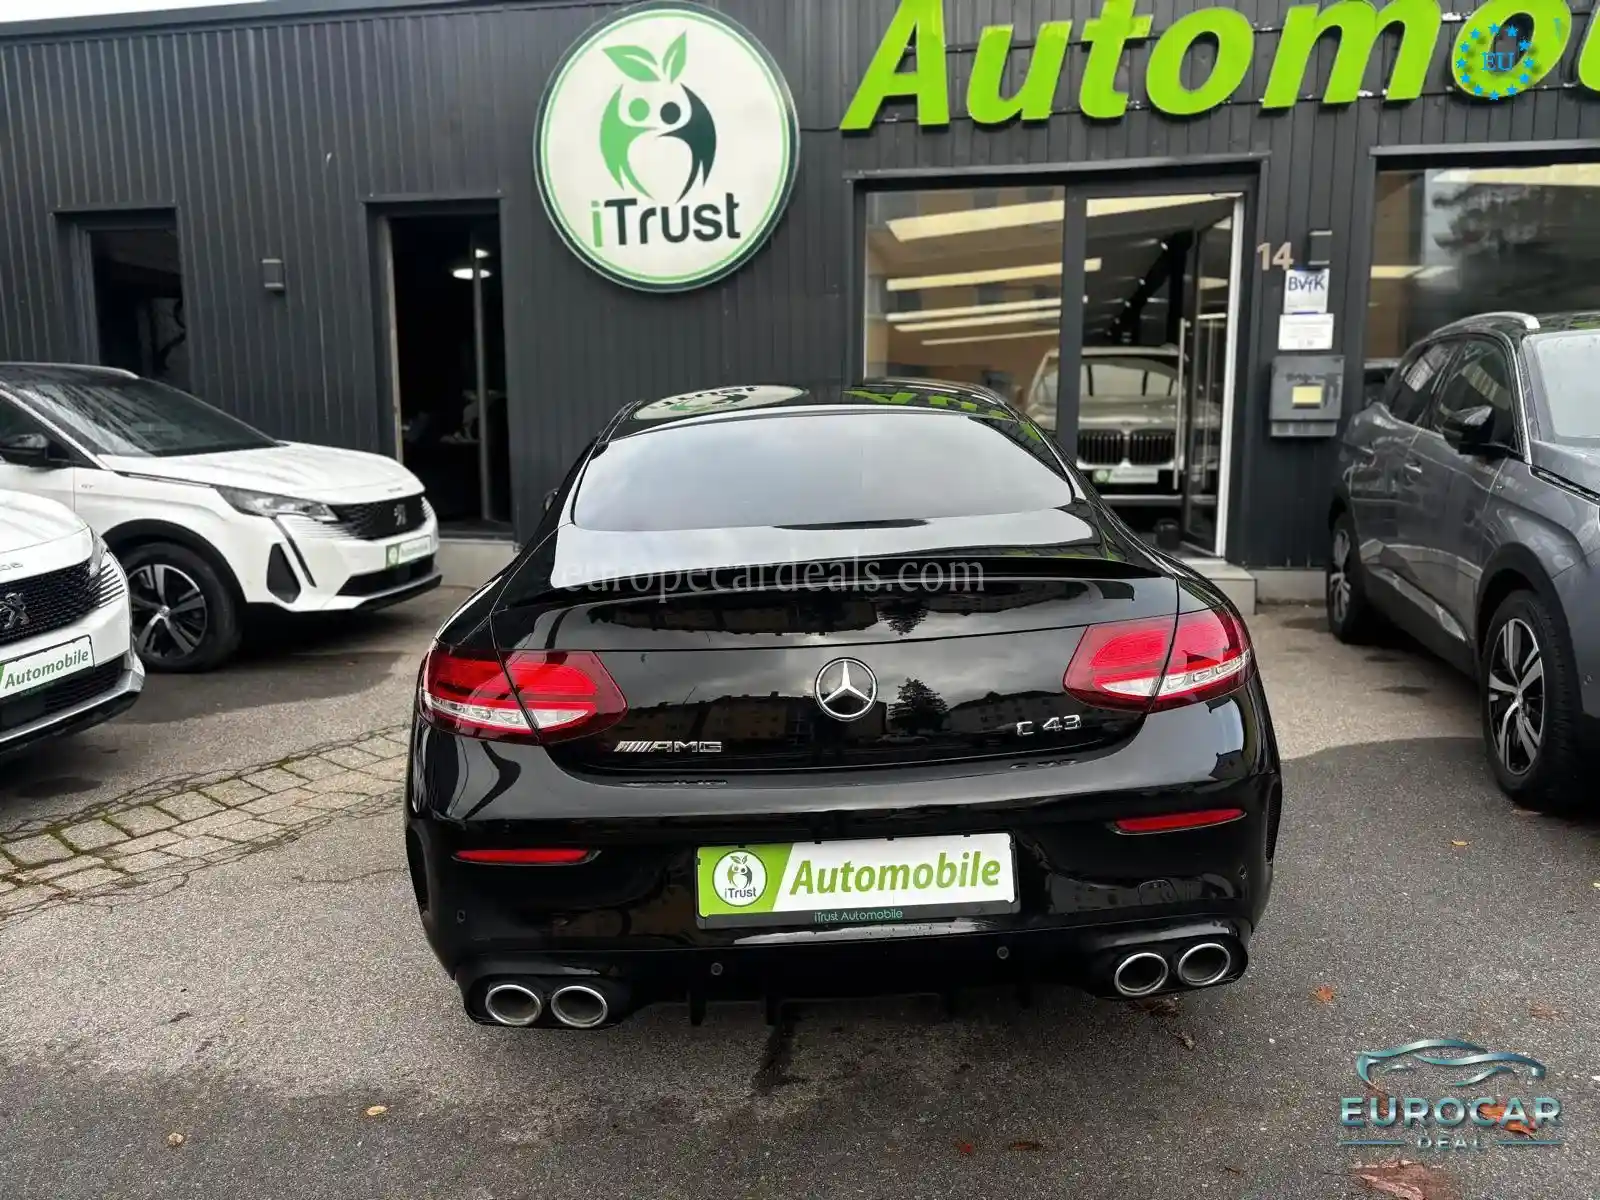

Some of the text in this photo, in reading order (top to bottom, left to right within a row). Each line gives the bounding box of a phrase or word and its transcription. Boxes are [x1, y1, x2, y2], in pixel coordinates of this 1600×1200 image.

[840, 0, 1600, 130] Automo
[591, 192, 741, 248] iTrust
[1256, 241, 1295, 271] 14
[4, 649, 90, 690] Automobile
[1016, 714, 1082, 736] C 43
[789, 850, 1002, 897] Automobile
[724, 886, 757, 899] iTrust
[841, 908, 903, 921] Automobile
